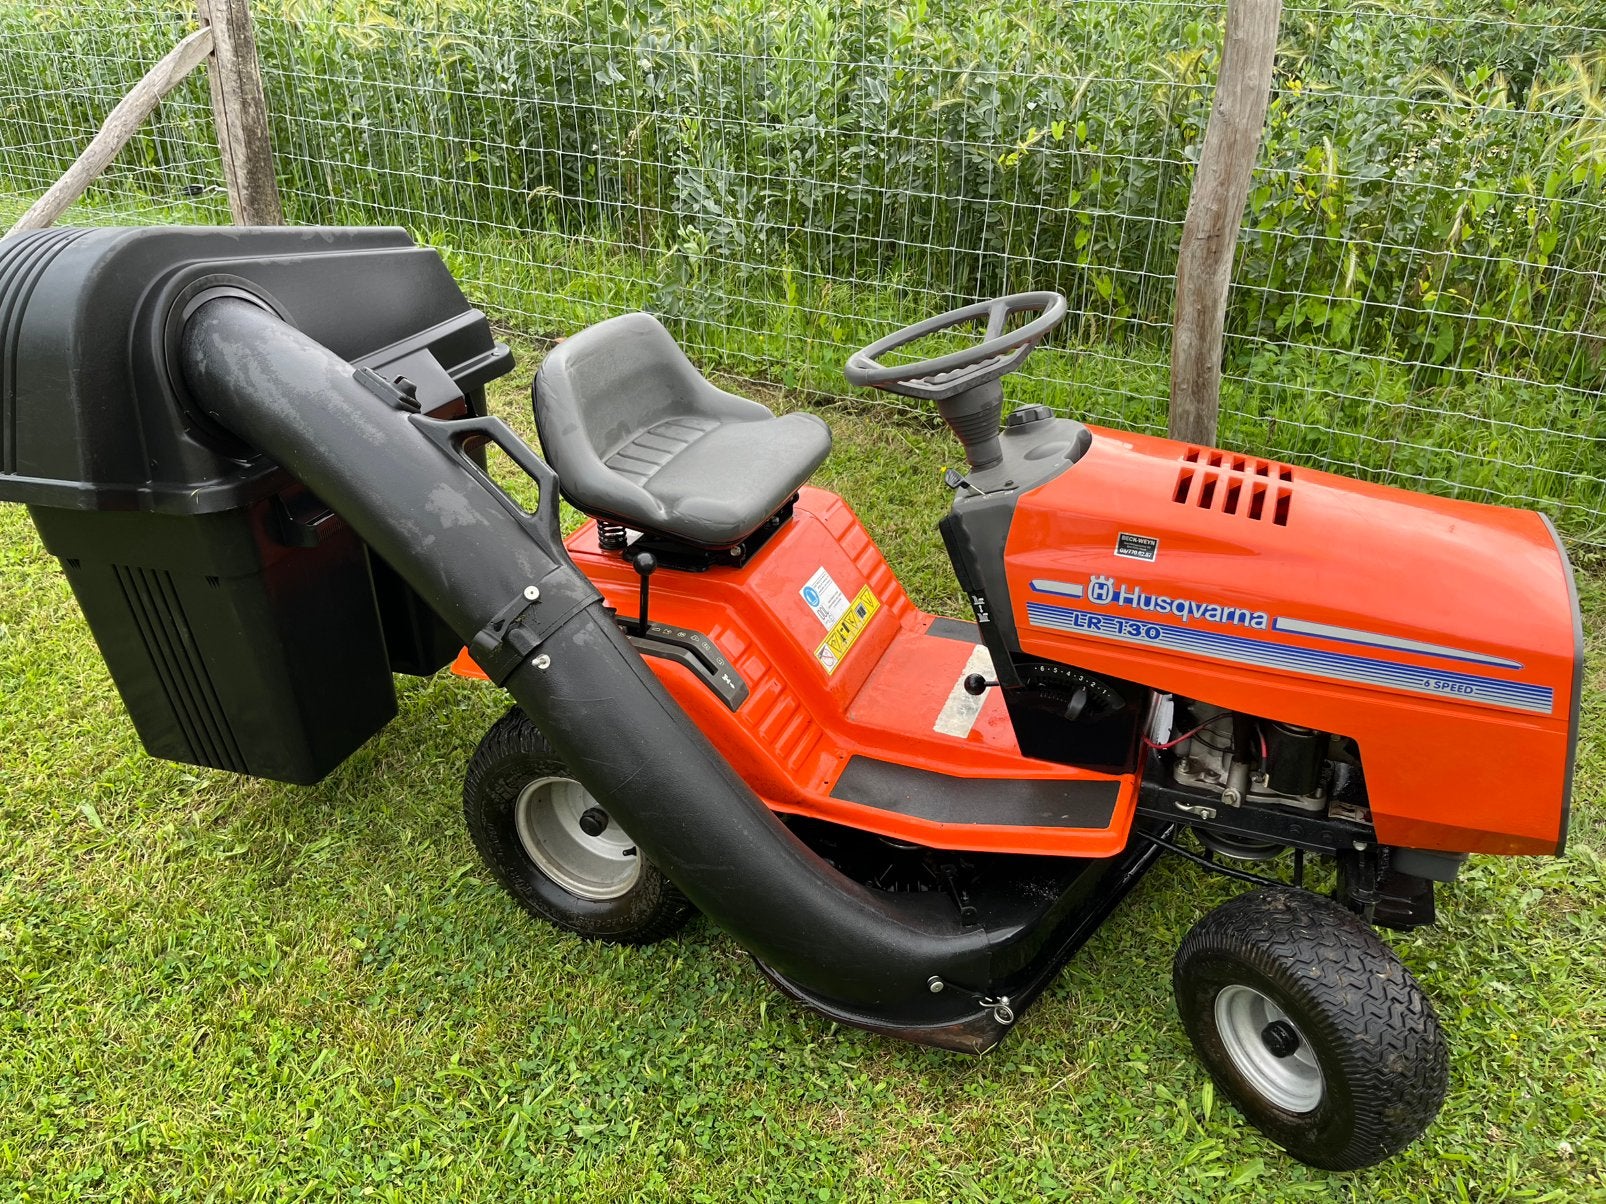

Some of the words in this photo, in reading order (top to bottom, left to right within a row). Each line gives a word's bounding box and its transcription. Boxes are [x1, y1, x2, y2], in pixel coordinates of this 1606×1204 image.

[1118, 584, 1268, 629] Husqvarna
[1073, 613, 1102, 631] LR
[1115, 620, 1162, 640] 130
[1423, 680, 1430, 688] 6
[1433, 681, 1474, 694] SPEED
